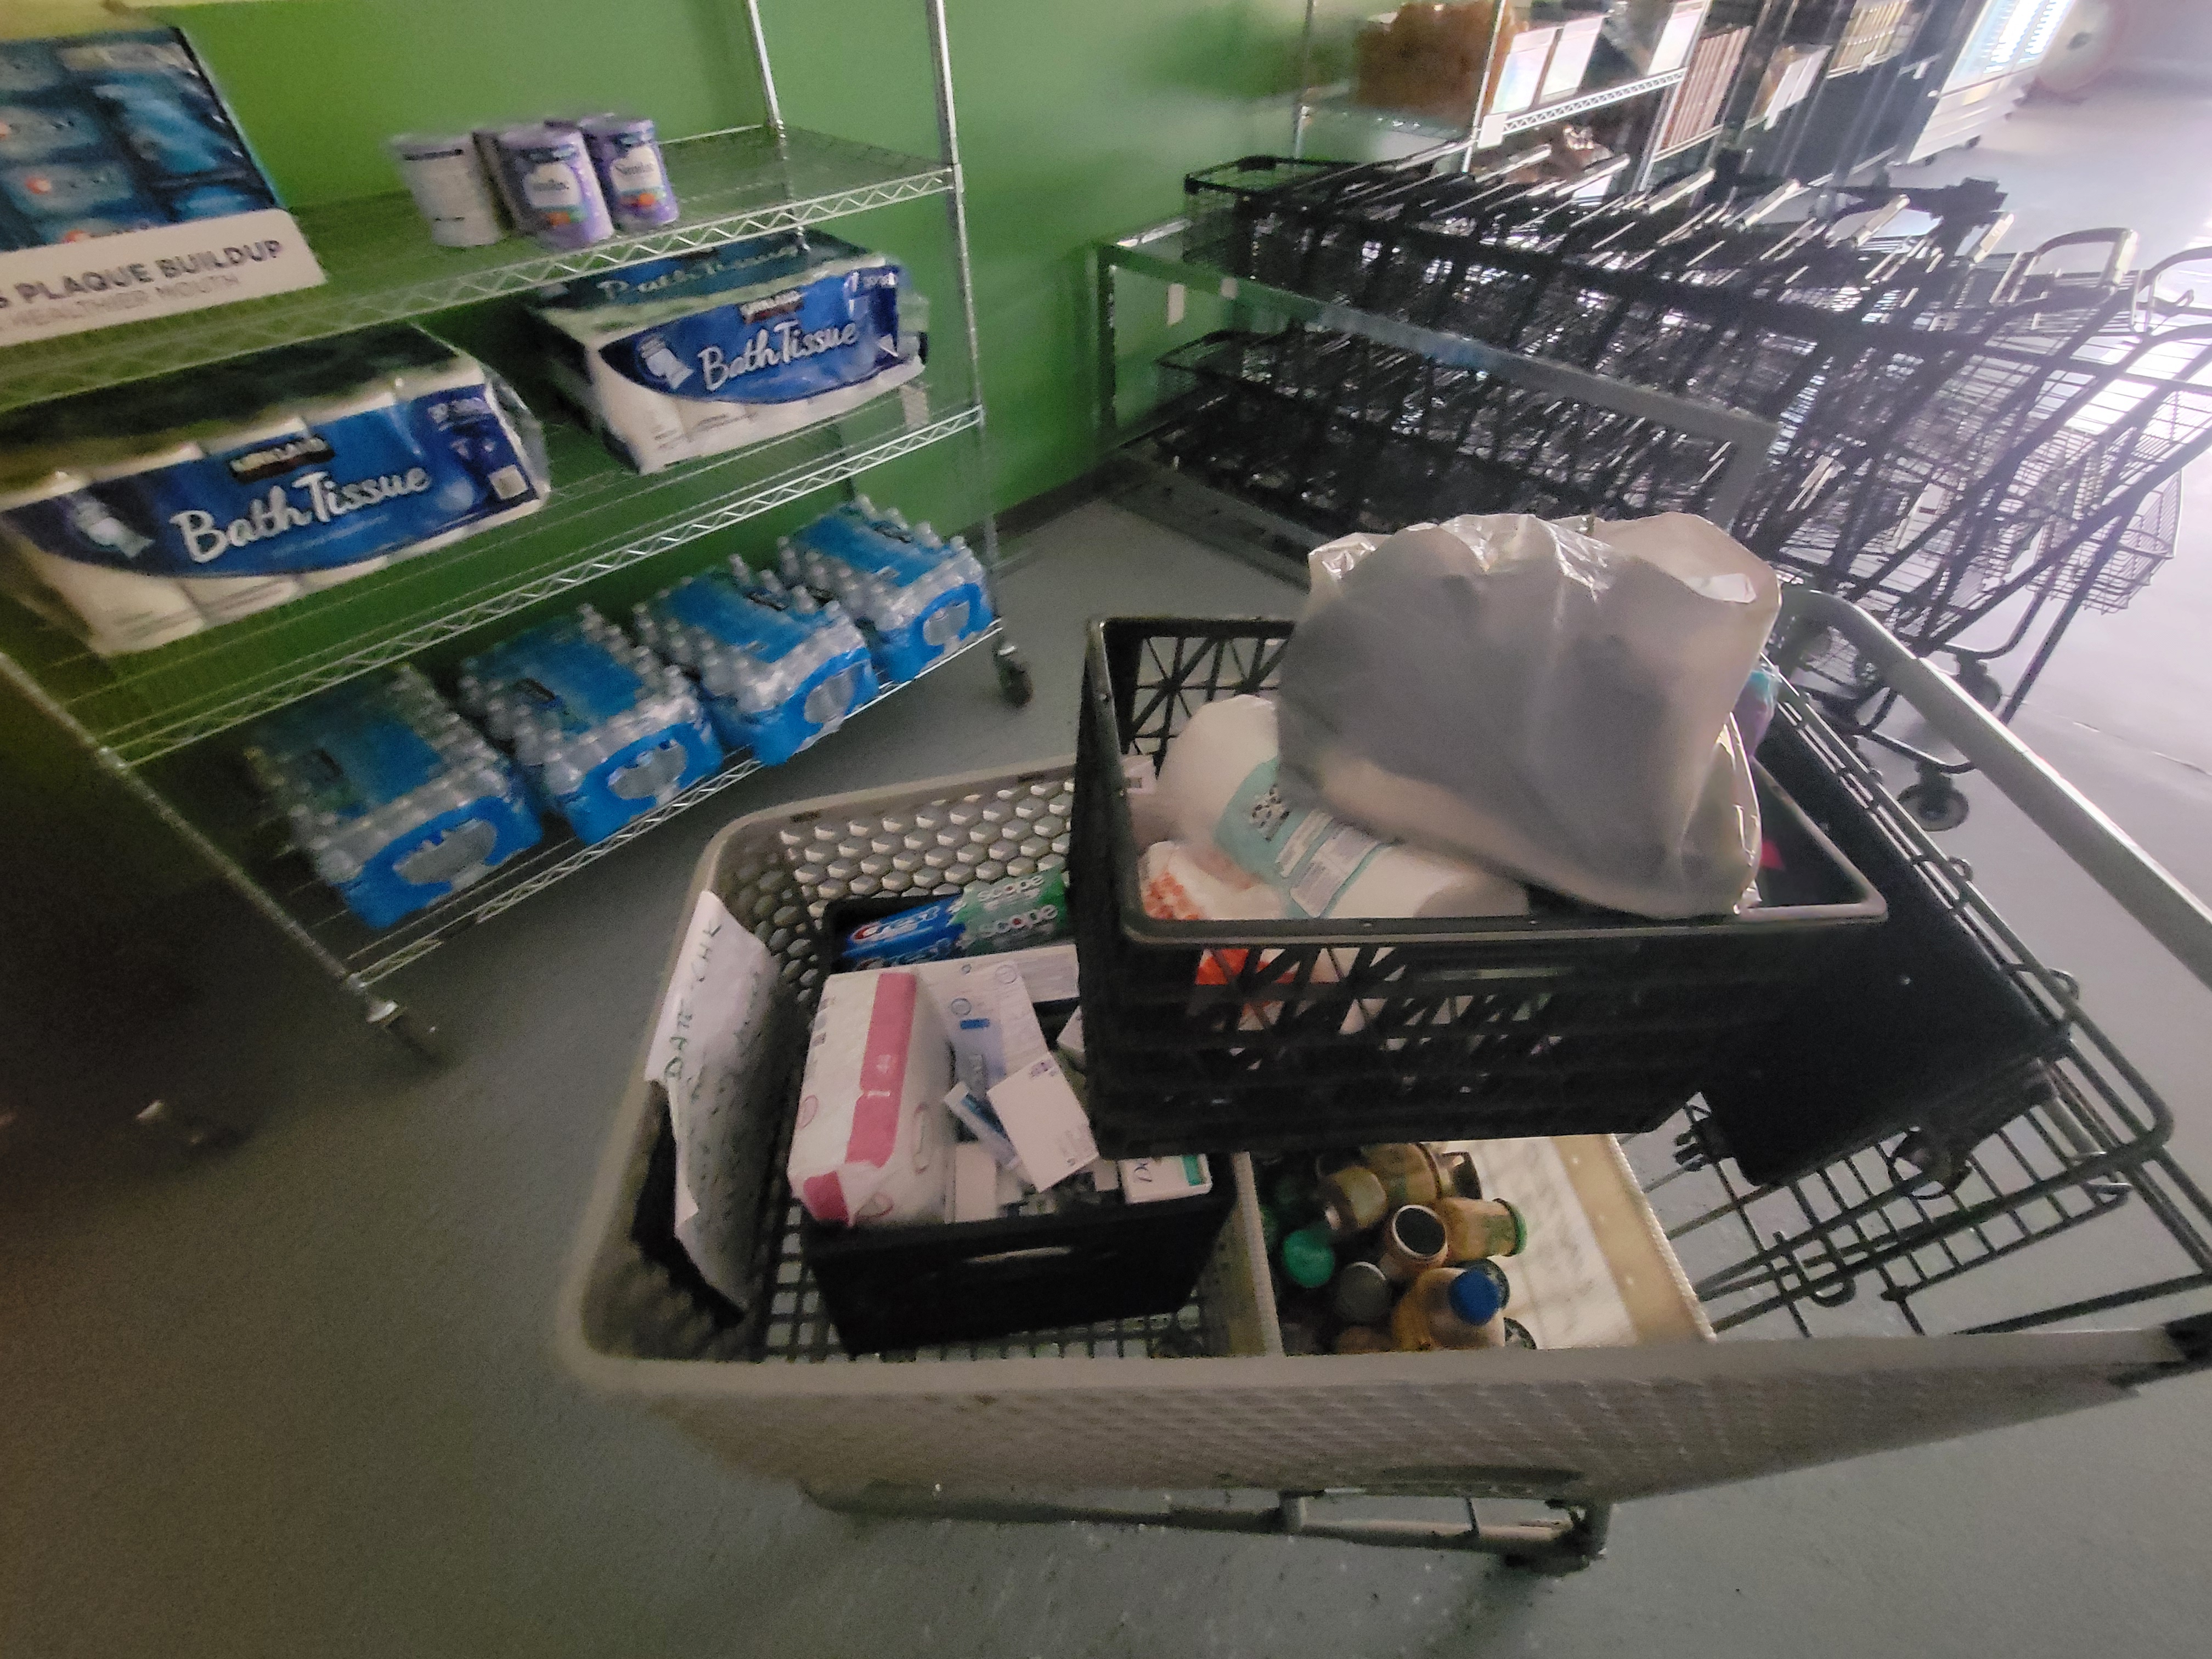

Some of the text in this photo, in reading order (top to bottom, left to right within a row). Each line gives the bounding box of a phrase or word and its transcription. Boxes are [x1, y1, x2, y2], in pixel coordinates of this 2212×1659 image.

[14, 240, 283, 303] PLAQUE BUILDUP
[697, 319, 857, 392] Bath Tissue
[169, 486, 313, 563] Bath
[291, 467, 432, 522] Tissue
[977, 874, 1045, 902] scope
[979, 904, 1059, 938] scope
